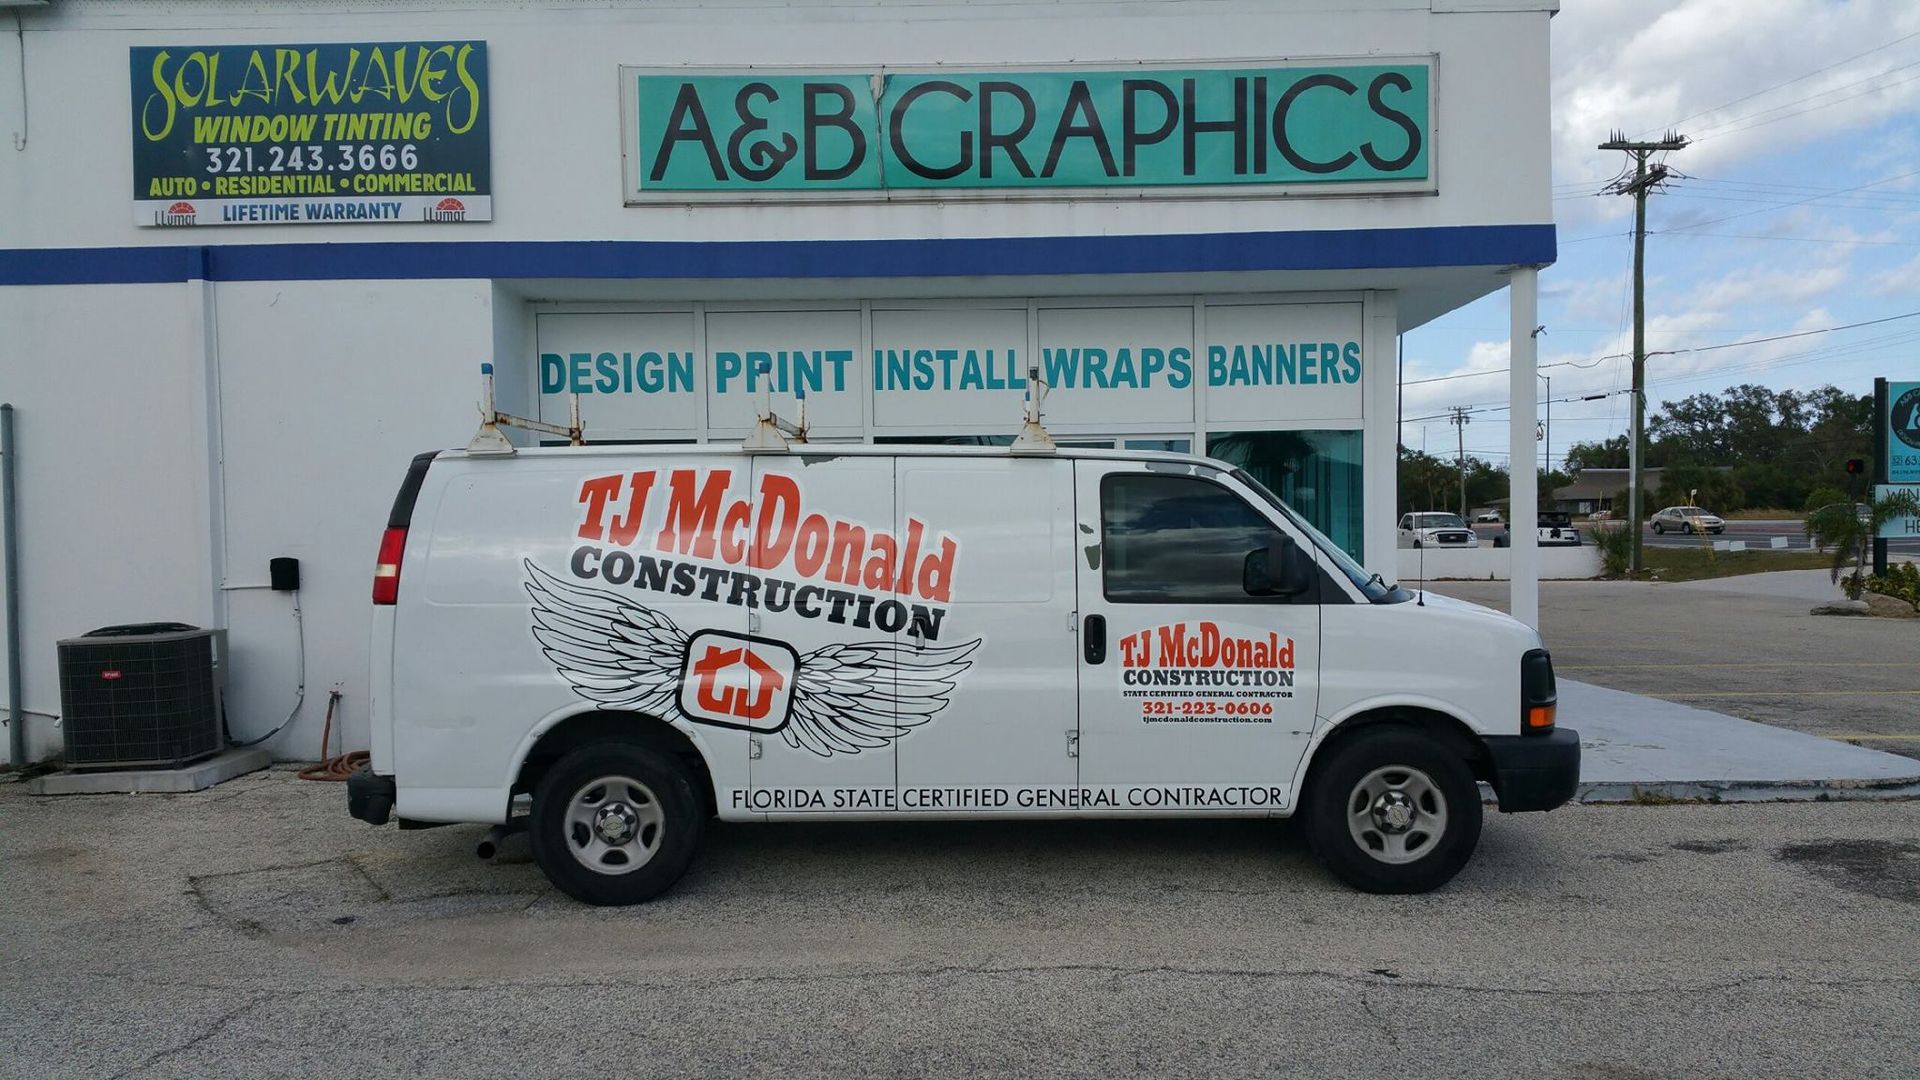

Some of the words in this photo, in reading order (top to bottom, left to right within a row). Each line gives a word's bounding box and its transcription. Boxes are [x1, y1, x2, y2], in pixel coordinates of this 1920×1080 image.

[143, 43, 479, 141] SOLARWAVES
[194, 115, 316, 143] WINDOW
[324, 112, 431, 141] TINTING
[650, 83, 866, 181] A&B
[890, 72, 1422, 179] GRAPHICS
[206, 145, 418, 173] 321.243.3666
[150, 177, 196, 196] AUTO
[216, 175, 335, 195] RESIDENTIAL
[353, 173, 475, 193] COMMERCIAL
[224, 204, 300, 221] LIFETIME
[305, 202, 401, 220] WARRANTY
[541, 352, 694, 394] DESIGN
[715, 350, 853, 393] PRINT
[874, 349, 1026, 390] INSTALL
[1043, 348, 1192, 389] WRAPS
[1208, 342, 1361, 386] BANNERS
[578, 470, 656, 546] TJ
[656, 469, 957, 603] McDonald
[570, 546, 945, 641] CONSTRUCTION
[1120, 629, 1151, 668] TJ
[1158, 621, 1295, 669] McDonald
[1124, 669, 1294, 686] CONSTRUCTION
[1142, 701, 1273, 714] 321-223-0606
[1149, 690, 1194, 698] CERTIFIED
[1195, 690, 1234, 698] GENERAL
[1143, 716, 1273, 724] tjmcdonaldconstruction.com
[732, 789, 825, 808] FLORIDA
[833, 789, 895, 808] STATE
[903, 788, 1009, 807] CERTIFIED
[1016, 788, 1120, 807] GENERAL
[1128, 787, 1281, 806] CONTRACTOR
